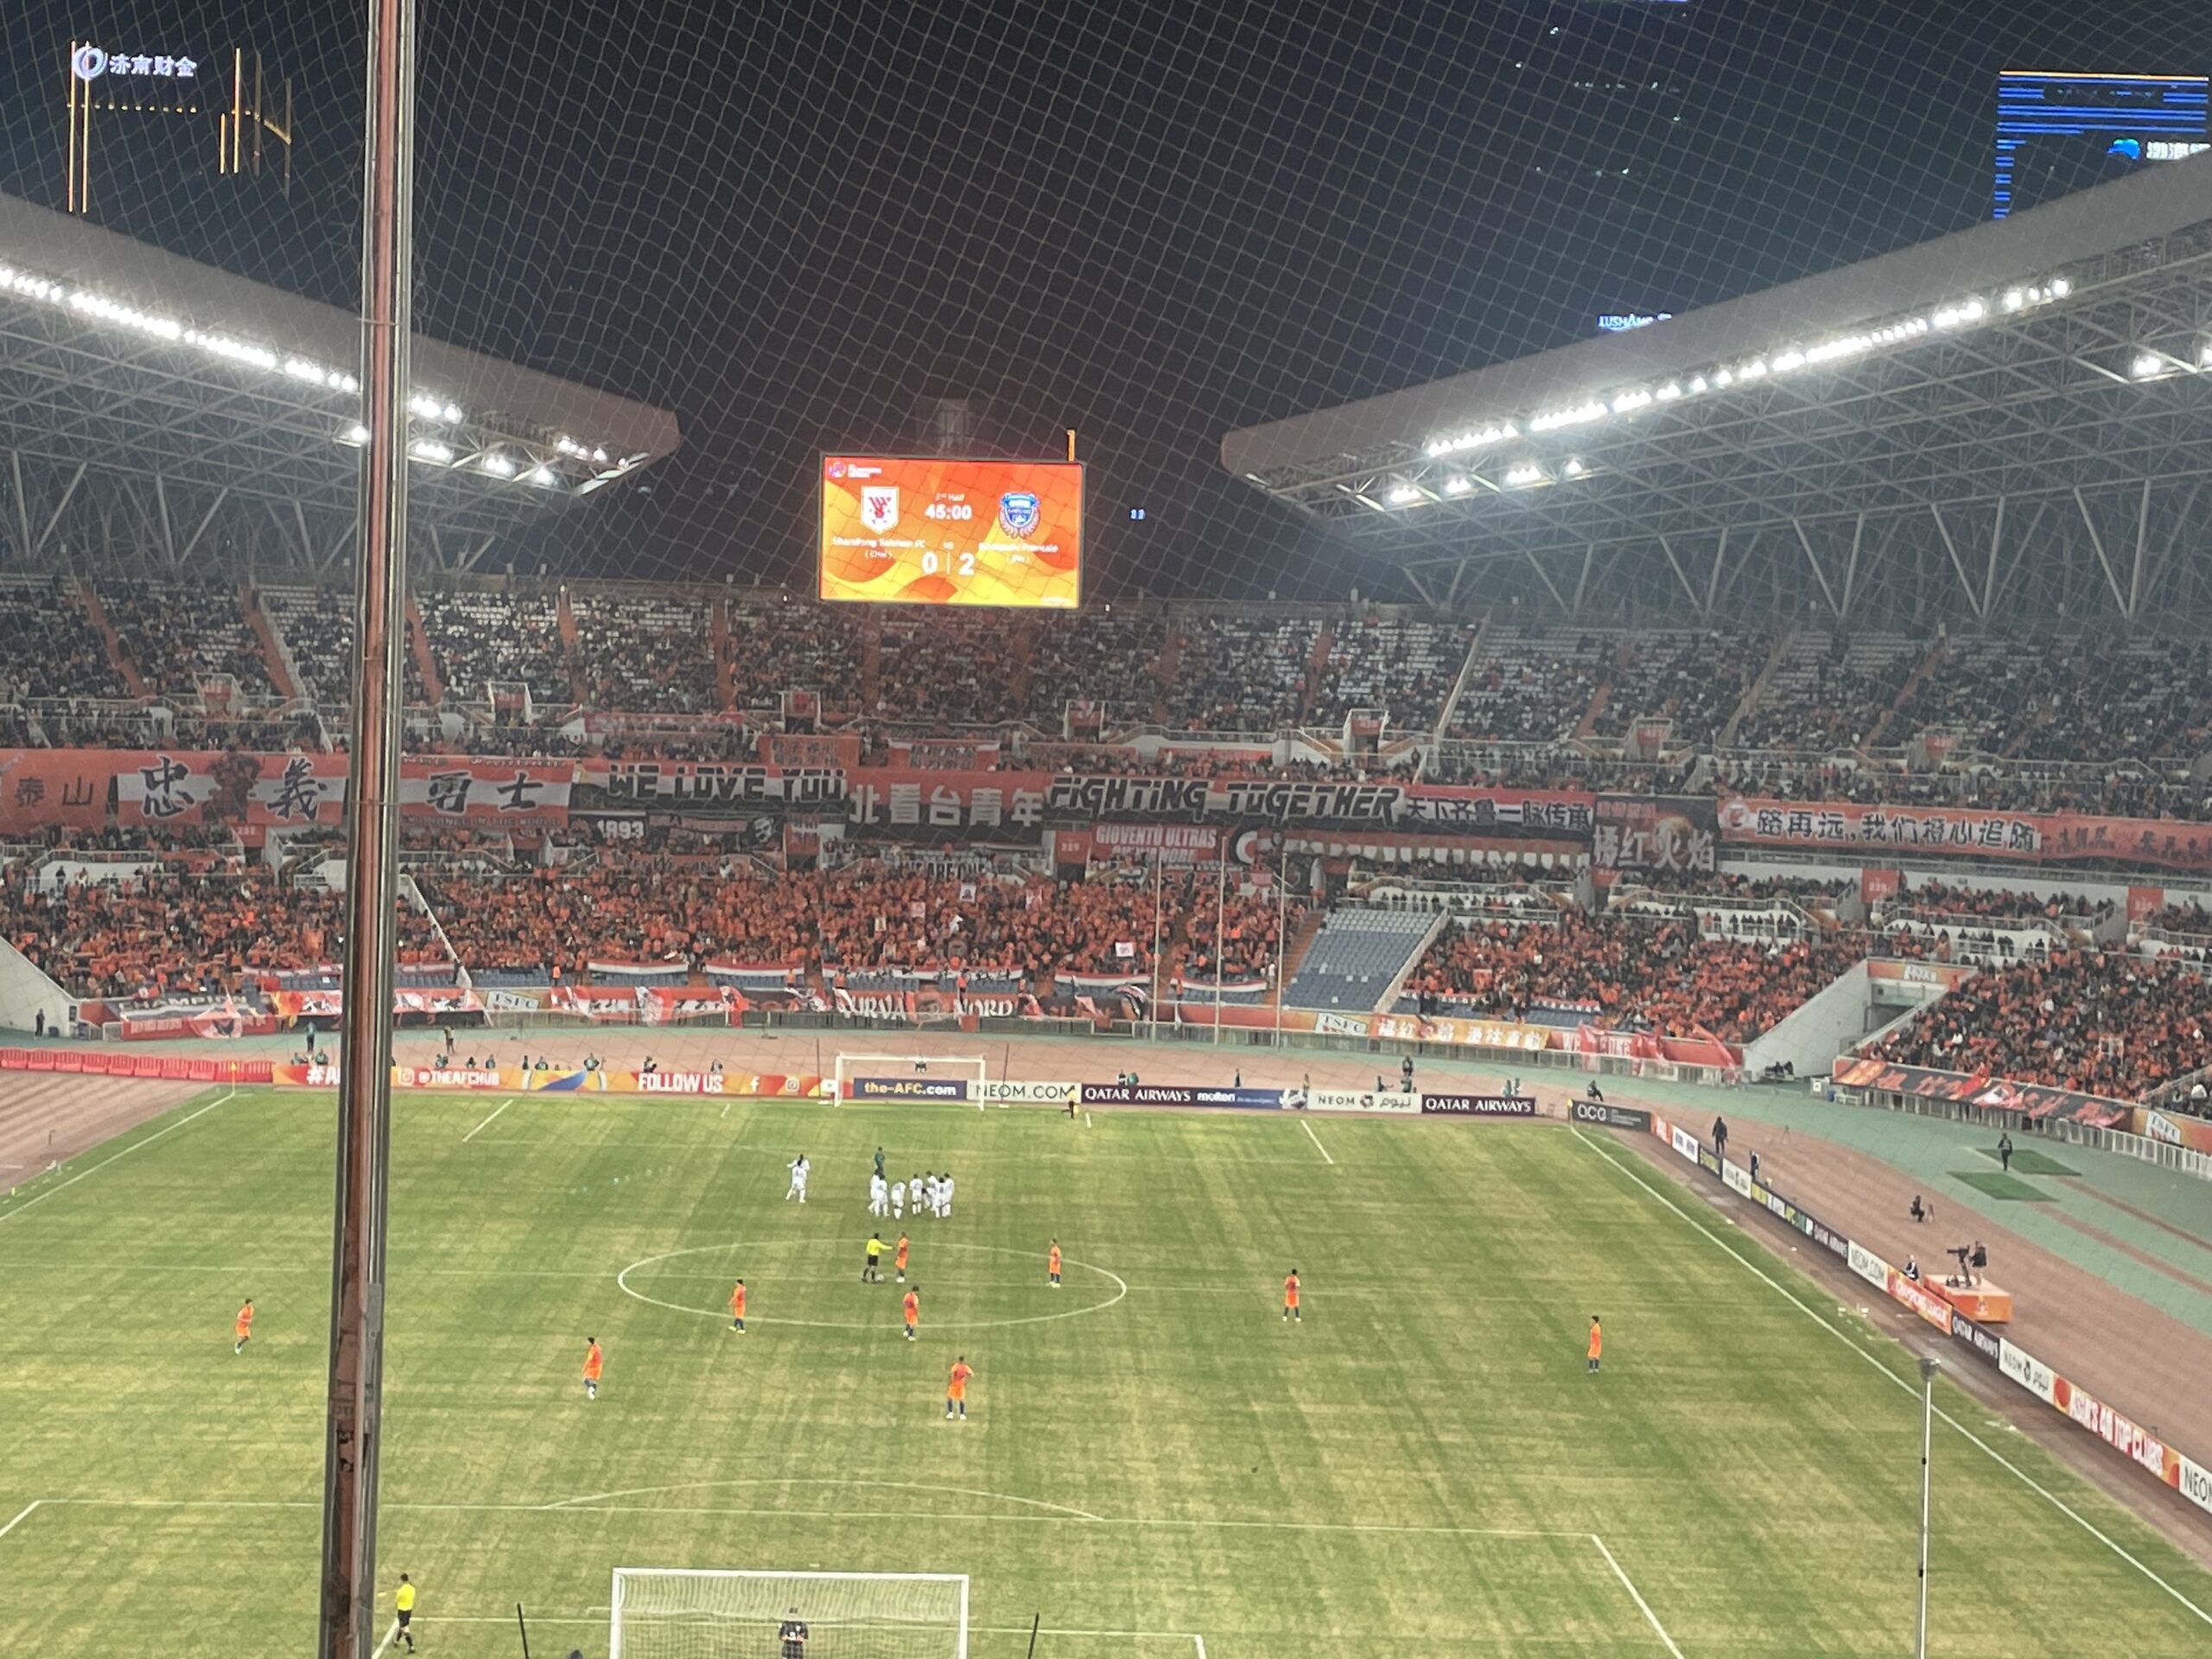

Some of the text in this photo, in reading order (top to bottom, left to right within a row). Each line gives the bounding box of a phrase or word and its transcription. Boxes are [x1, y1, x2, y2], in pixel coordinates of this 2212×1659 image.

[110, 54, 197, 77] 济南财金
[925, 505, 973, 520] 45:00
[922, 552, 938, 574] 0
[958, 553, 975, 575] 2
[15, 775, 93, 808] 泰山
[138, 753, 196, 820] 忠
[608, 764, 848, 803] WE LOVE YOU
[849, 783, 1045, 828] 北看台青年
[1225, 781, 1405, 827] TOGETHER
[1406, 797, 1592, 830] 天下齐鲁一脉传承
[1165, 826, 1217, 849] ULTRAS
[639, 1072, 724, 1092] FOLLOW US
[864, 1081, 957, 1096] the-AFC.com
[1084, 1087, 1192, 1103] QATAR AIRWAYS
[1197, 1090, 1236, 1103] molten
[1318, 1096, 1356, 1106] NEOM
[1425, 1097, 1532, 1114] QATAR AIRWAYS
